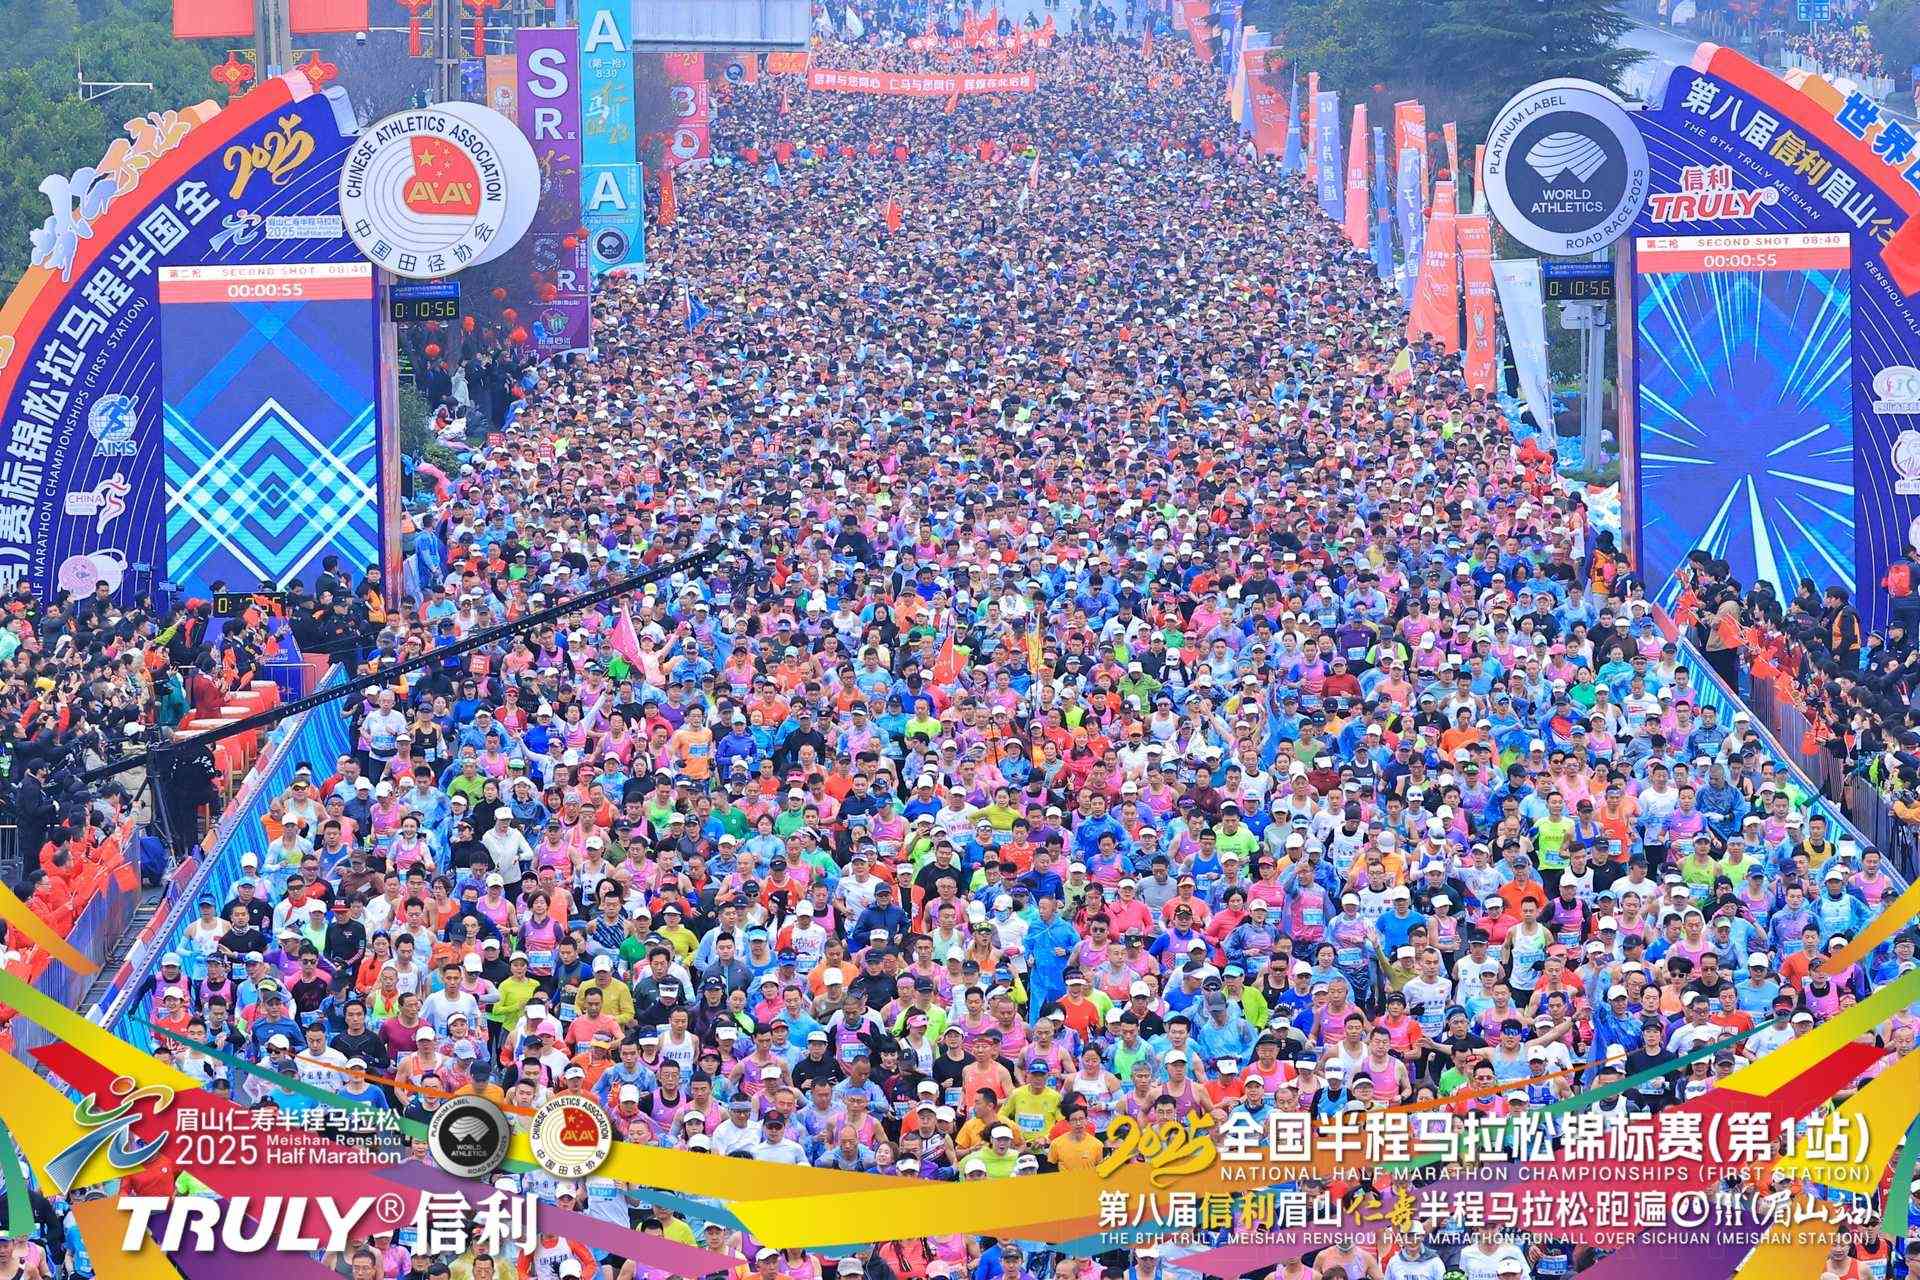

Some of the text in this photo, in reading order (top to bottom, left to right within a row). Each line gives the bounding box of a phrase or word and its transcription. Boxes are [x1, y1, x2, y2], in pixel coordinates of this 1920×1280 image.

[584, 9, 625, 52] A
[528, 48, 569, 99] S
[1490, 96, 1566, 175] PLATINUM LABEL
[346, 116, 502, 202] CHINESE ATHLETICS ASSOCIATION
[1684, 167, 1729, 190] 信利
[590, 172, 627, 210] A
[1543, 189, 1591, 200] WORLD
[1566, 232, 1603, 249] ROAD
[1604, 206, 1633, 236] RACE
[1629, 169, 1644, 204] 2025
[1683, 120, 1707, 137] THE
[1710, 135, 1734, 154] 8TH
[1738, 152, 1773, 179] TRULY
[1774, 179, 1821, 221] MEISHAN
[1864, 260, 1904, 307] RENSHOU
[354, 218, 495, 273] 中国田径协会
[1697, 238, 1750, 247] SECOND
[1756, 237, 1790, 246] SHOT
[1802, 236, 1841, 245] 08:40
[1704, 254, 1777, 268] 00:00:55
[222, 268, 275, 277] SECOND
[329, 265, 368, 274] 08:40
[228, 283, 303, 297] 00:00:55
[34, 502, 53, 577] MARATHON
[45, 390, 89, 497] CHAMPIONSHIPS
[85, 349, 110, 388] (FIRST
[107, 296, 149, 349] STATION)
[95, 440, 137, 456] AIMS
